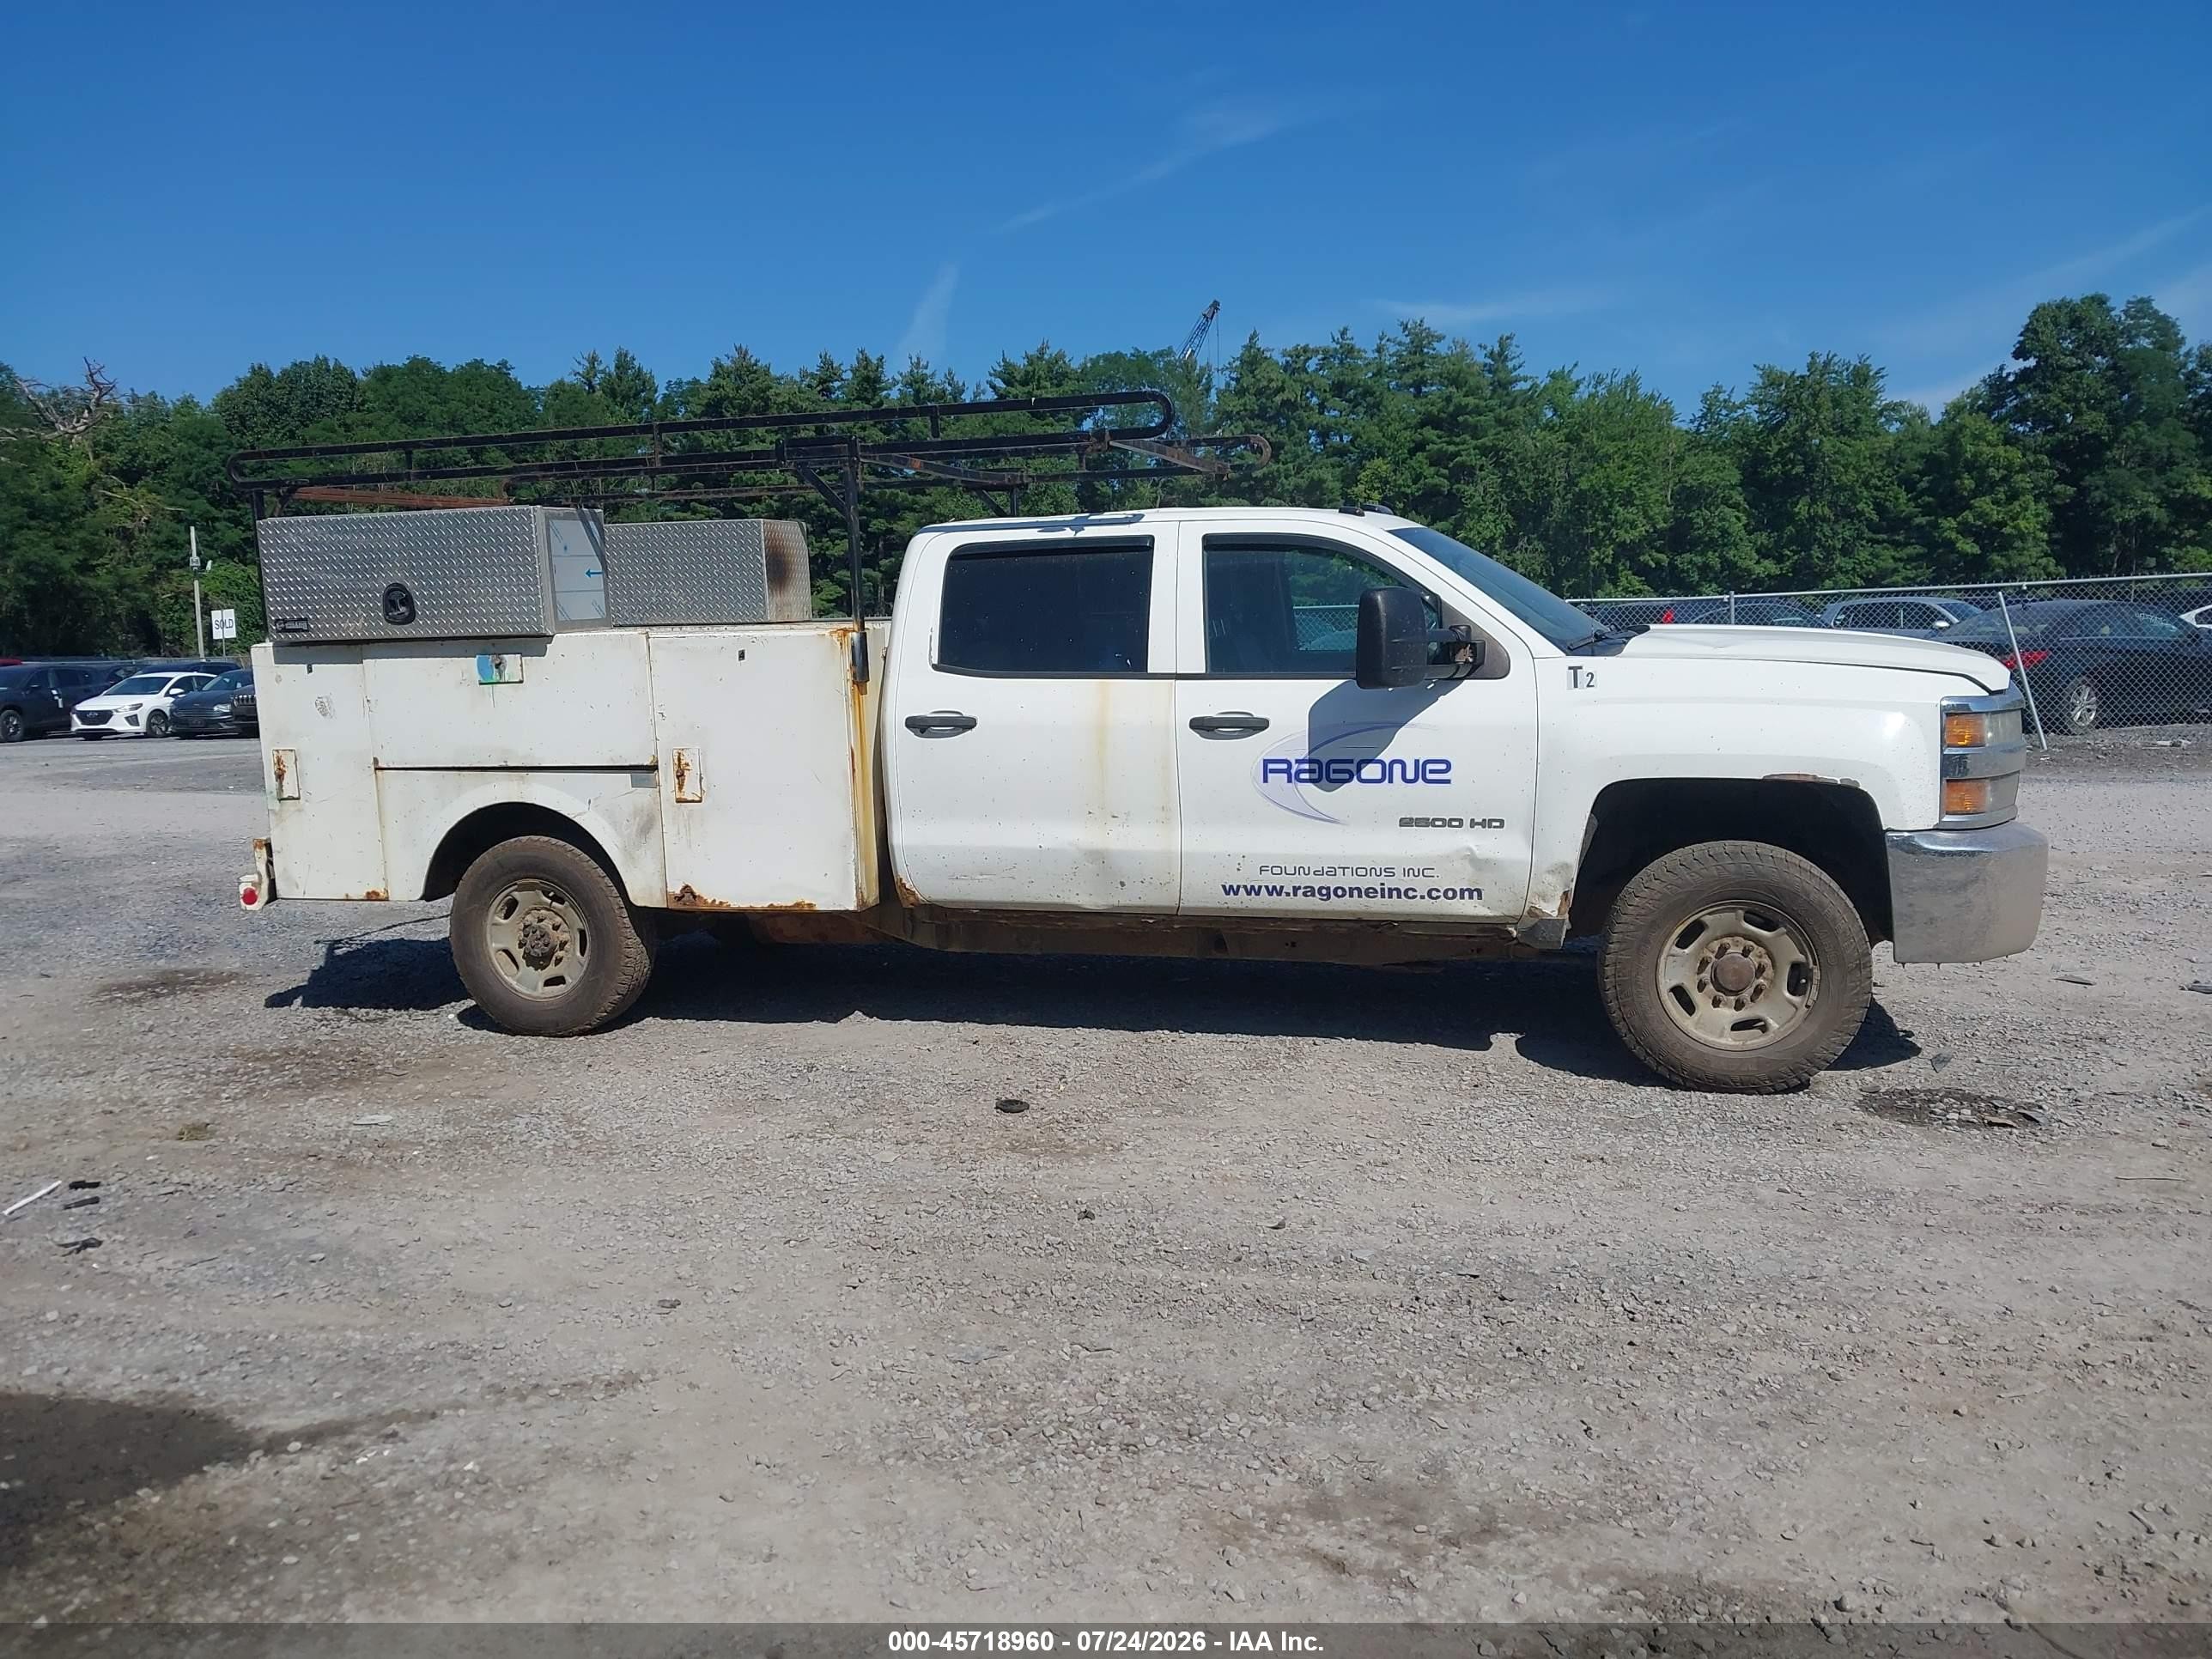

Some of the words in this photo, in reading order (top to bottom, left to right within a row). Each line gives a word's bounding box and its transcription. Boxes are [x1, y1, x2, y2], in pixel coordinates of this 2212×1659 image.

[215, 618, 234, 630] SOLD
[1399, 817, 1463, 829] 2500
[1469, 817, 1504, 829] HD
[1402, 866, 1440, 878] INC.
[1223, 883, 1483, 901] www.ragoneinc.com
